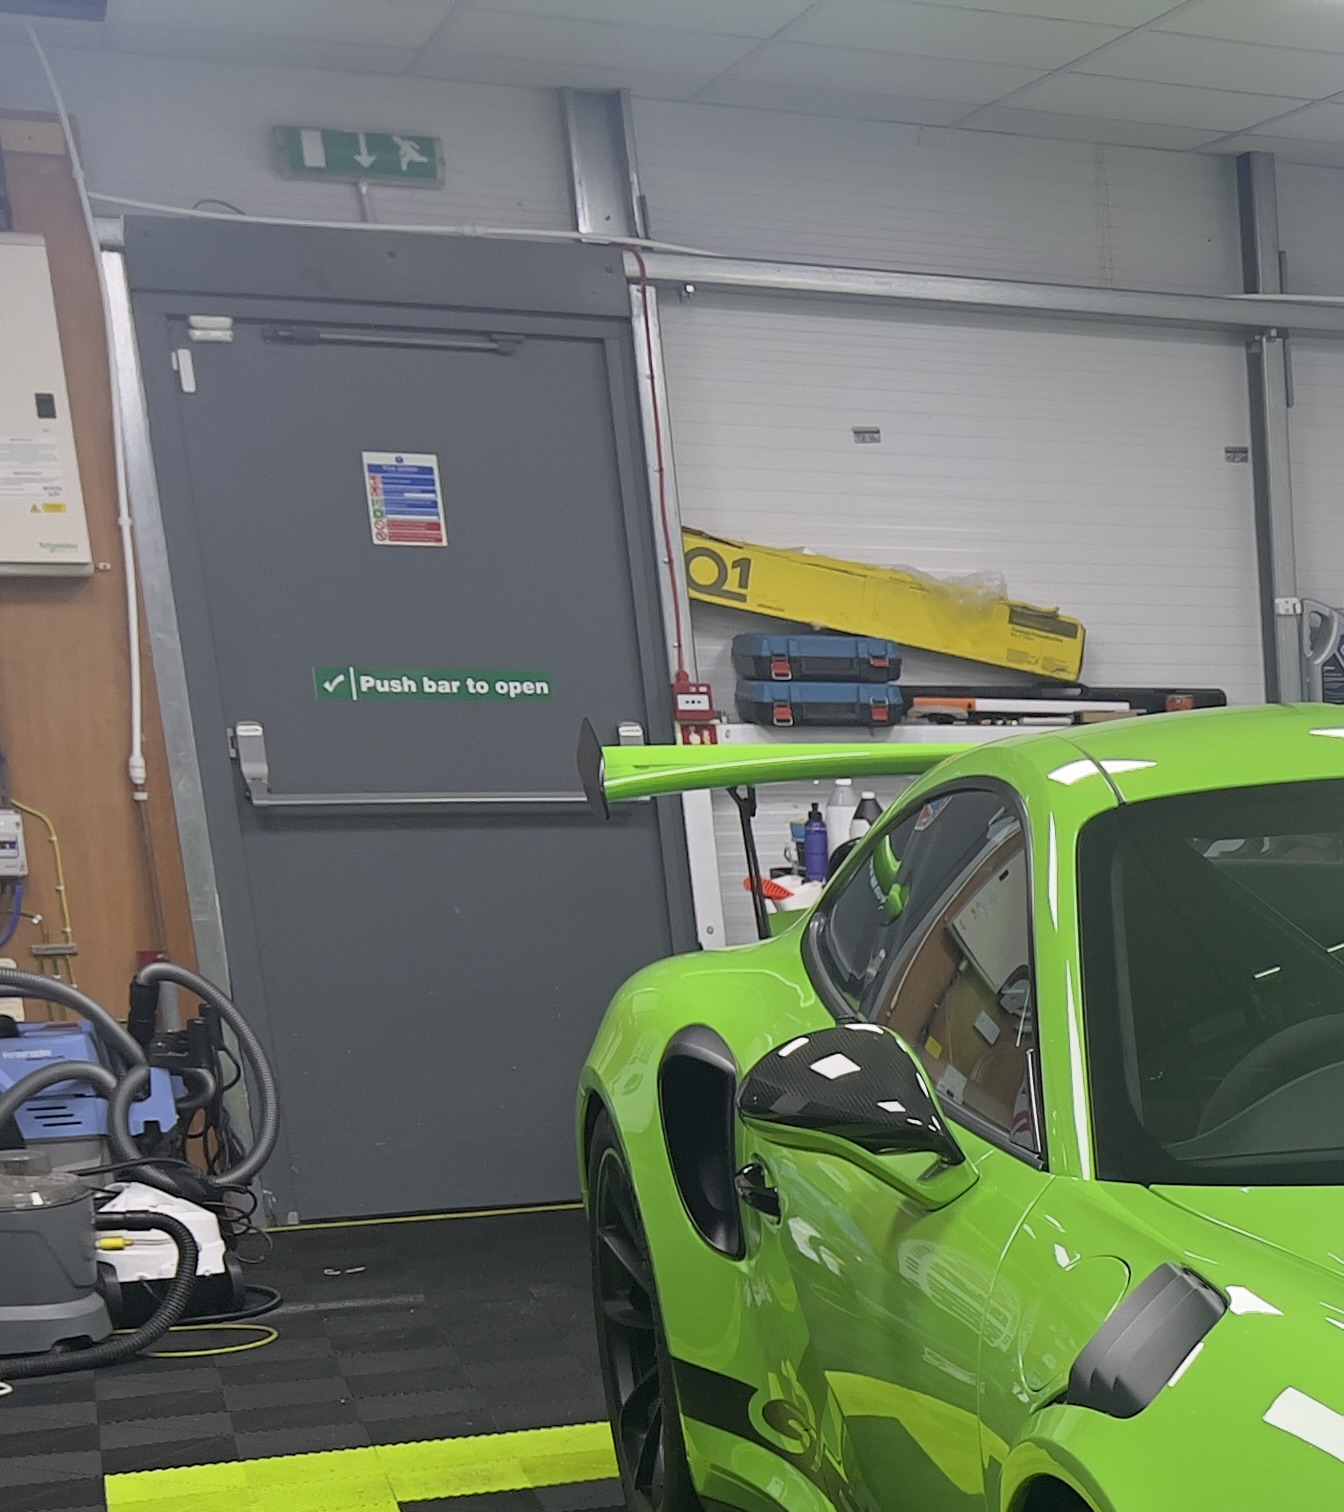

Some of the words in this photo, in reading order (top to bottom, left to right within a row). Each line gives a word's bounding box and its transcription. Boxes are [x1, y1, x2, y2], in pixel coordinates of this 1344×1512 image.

[360, 675, 417, 693] Push
[422, 677, 459, 694] bar
[466, 677, 489, 694] to
[495, 680, 549, 698] open
